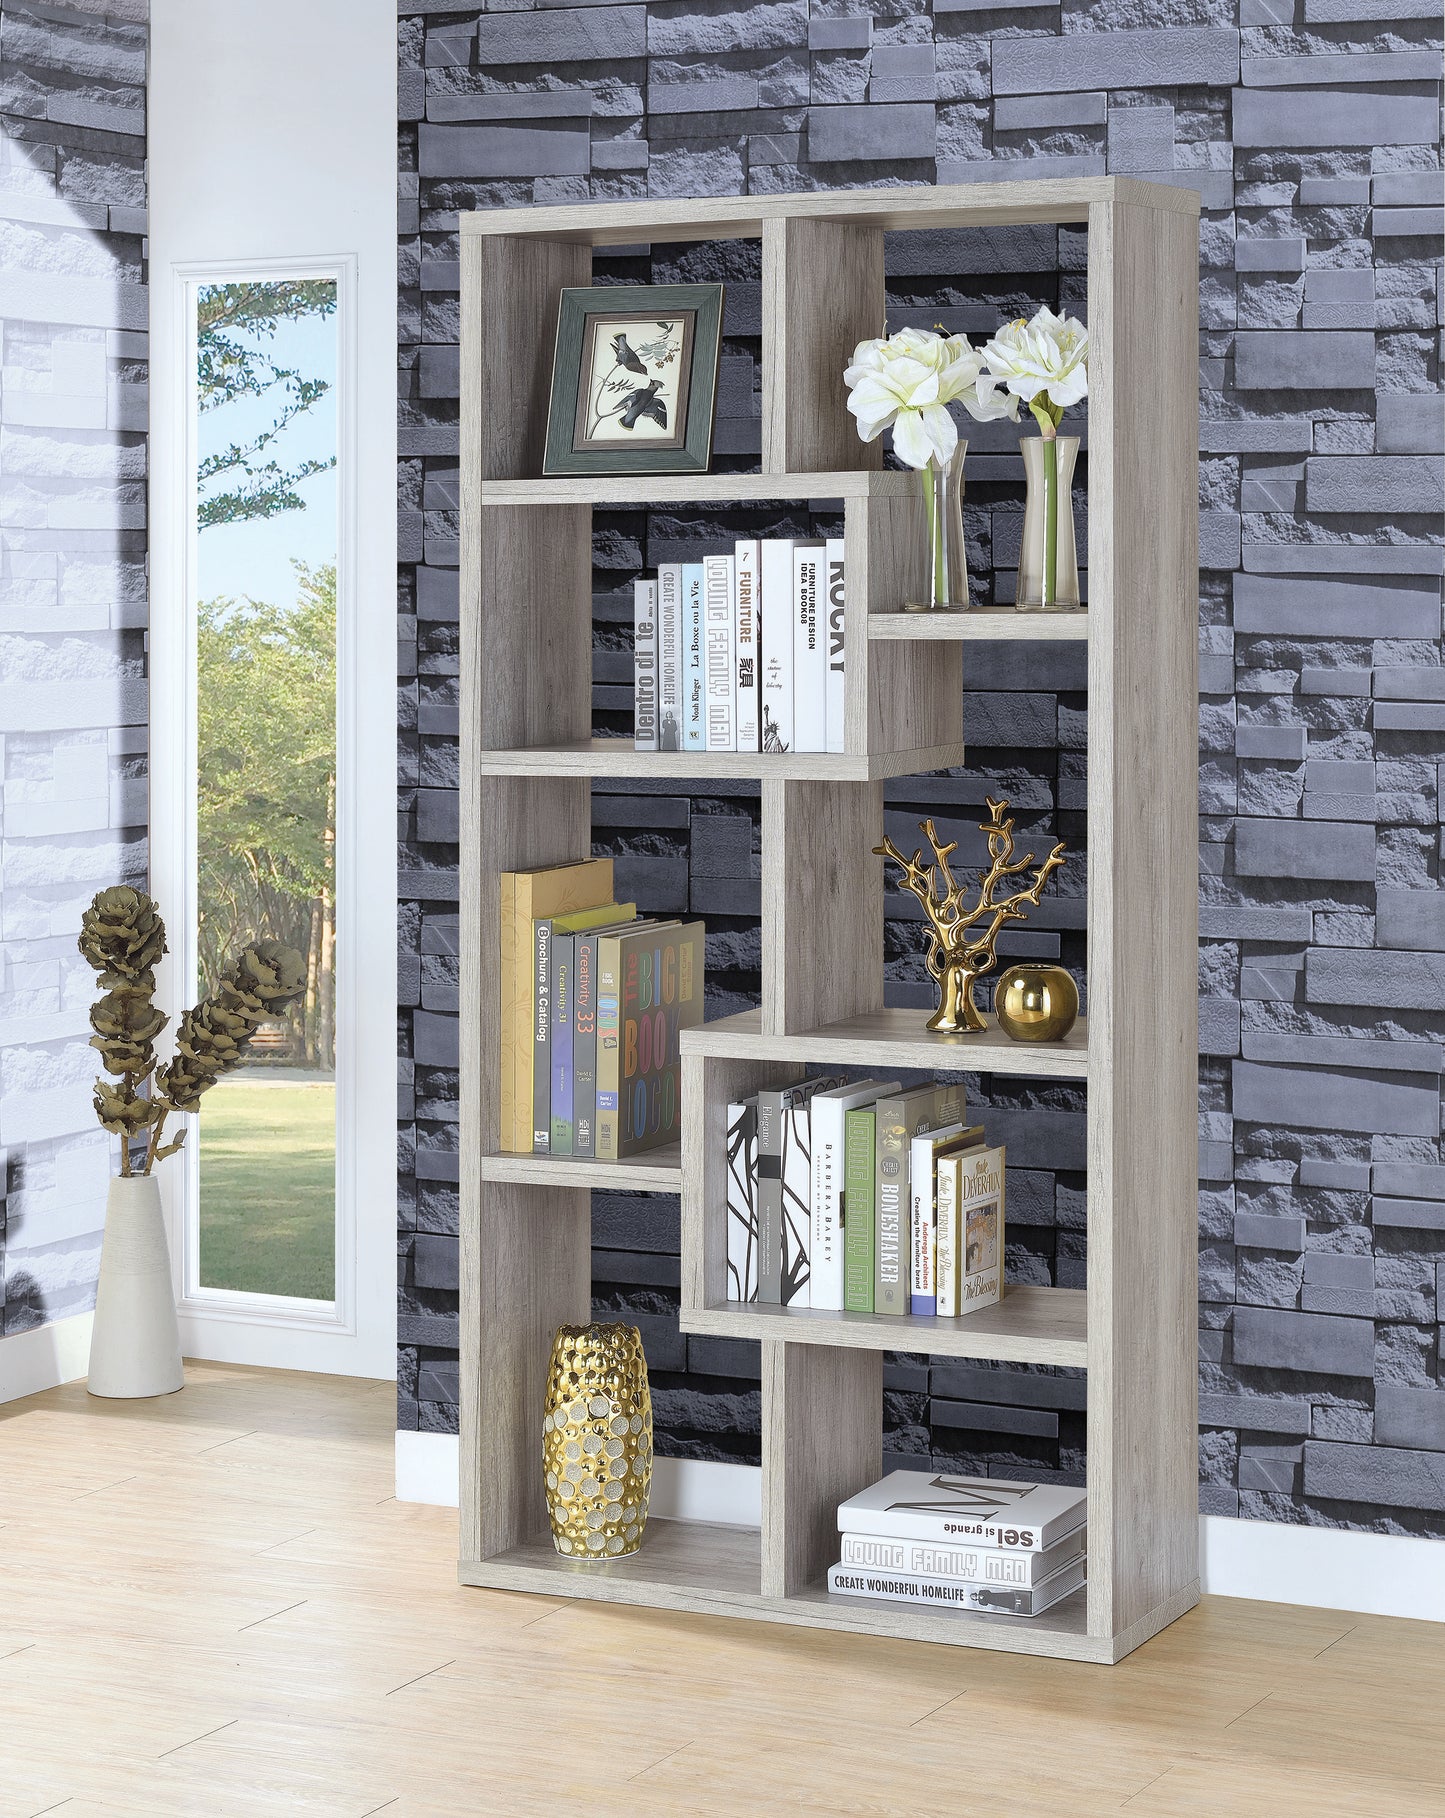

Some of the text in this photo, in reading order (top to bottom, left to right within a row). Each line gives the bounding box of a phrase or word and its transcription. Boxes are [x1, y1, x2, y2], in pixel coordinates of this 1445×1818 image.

[742, 552, 749, 562] 7
[691, 580, 700, 668] La Boxe ou la Vie
[739, 571, 751, 643] FURNITURE
[800, 563, 808, 625] IDEA BOOK08
[808, 563, 816, 650] FURNITURE DESIGN
[663, 571, 675, 704] CREATE WONDERFUL HOMELIFE
[708, 628, 729, 696] FAMILY
[635, 622, 654, 741] Dentro di te
[692, 678, 701, 702] Klieger
[709, 704, 730, 745] MAN
[536, 926, 550, 1042] Brochure & Catalog
[558, 965, 567, 1011] Creativity
[577, 945, 594, 1034] Creativity 33
[639, 945, 676, 1011] BIG
[598, 991, 618, 1038] LOGOS
[624, 1007, 681, 1079] BOOK
[760, 1105, 773, 1148] Elegance
[963, 1171, 1000, 1201] DEVERAUX
[848, 1187, 869, 1257] FAMILY
[881, 1183, 899, 1283] BONESHAKER
[847, 1264, 869, 1308] MAN
[963, 1275, 998, 1300] The Blessing
[845, 1540, 1026, 1583] LOVING FAMILY MAN
[943, 1523, 1034, 1548] sei si grande
[834, 1575, 965, 1602] CREATE WONDERFUL HOMELIFE
